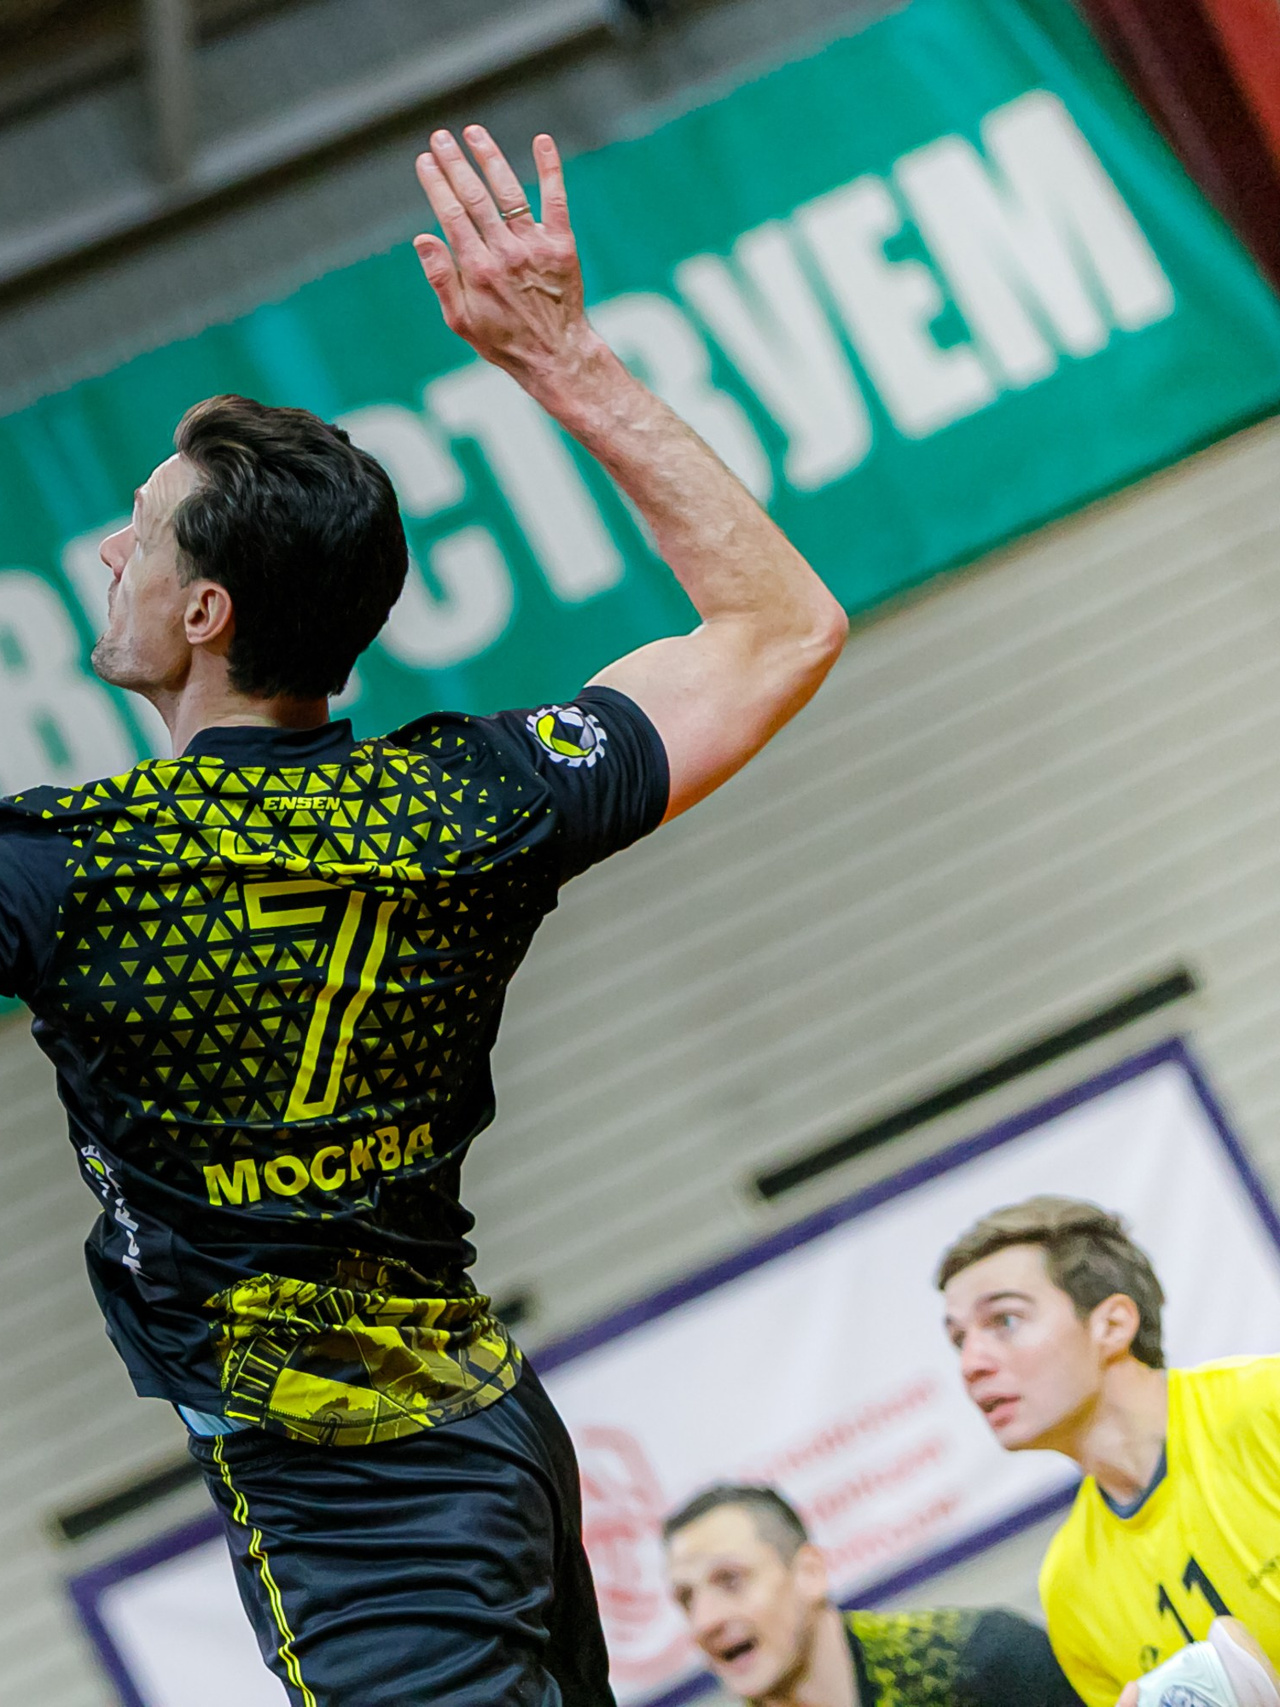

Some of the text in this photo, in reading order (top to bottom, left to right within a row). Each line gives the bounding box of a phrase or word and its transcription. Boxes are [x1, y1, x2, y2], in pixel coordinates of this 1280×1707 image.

[262, 796, 340, 811] ENSEN
[243, 878, 399, 1123] 7
[203, 1122, 435, 1206] МОСКВА
[1157, 1556, 1233, 1643] 11
